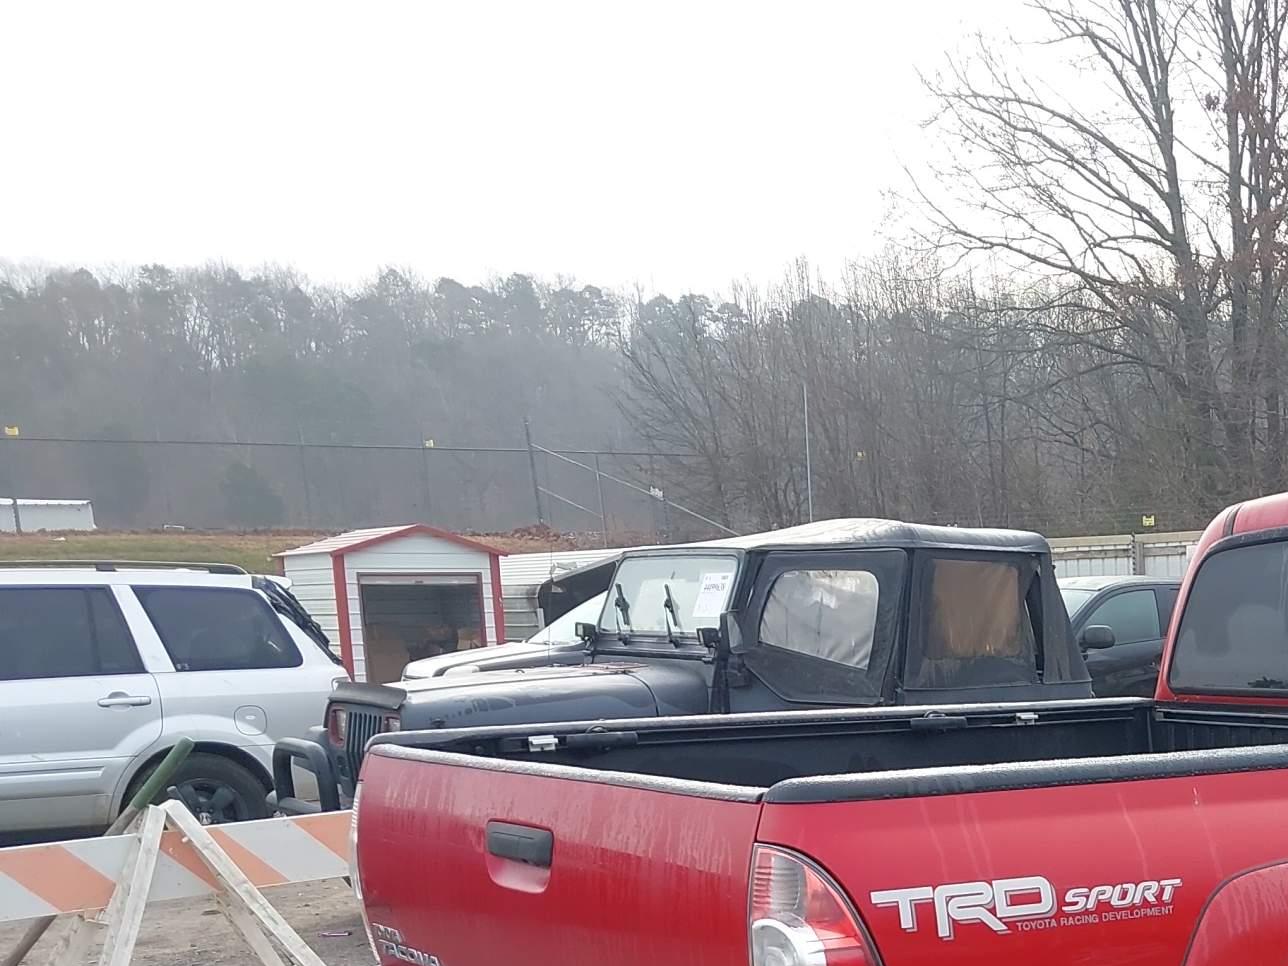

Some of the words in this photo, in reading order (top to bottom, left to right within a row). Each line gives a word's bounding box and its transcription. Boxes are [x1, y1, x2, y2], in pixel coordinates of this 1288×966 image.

[870, 875, 1056, 940] TRD
[1061, 878, 1183, 912] SPORT
[1016, 919, 1058, 932] TOYOTA
[1060, 913, 1099, 926] RACING
[1101, 904, 1175, 923] DEVELOPMENT
